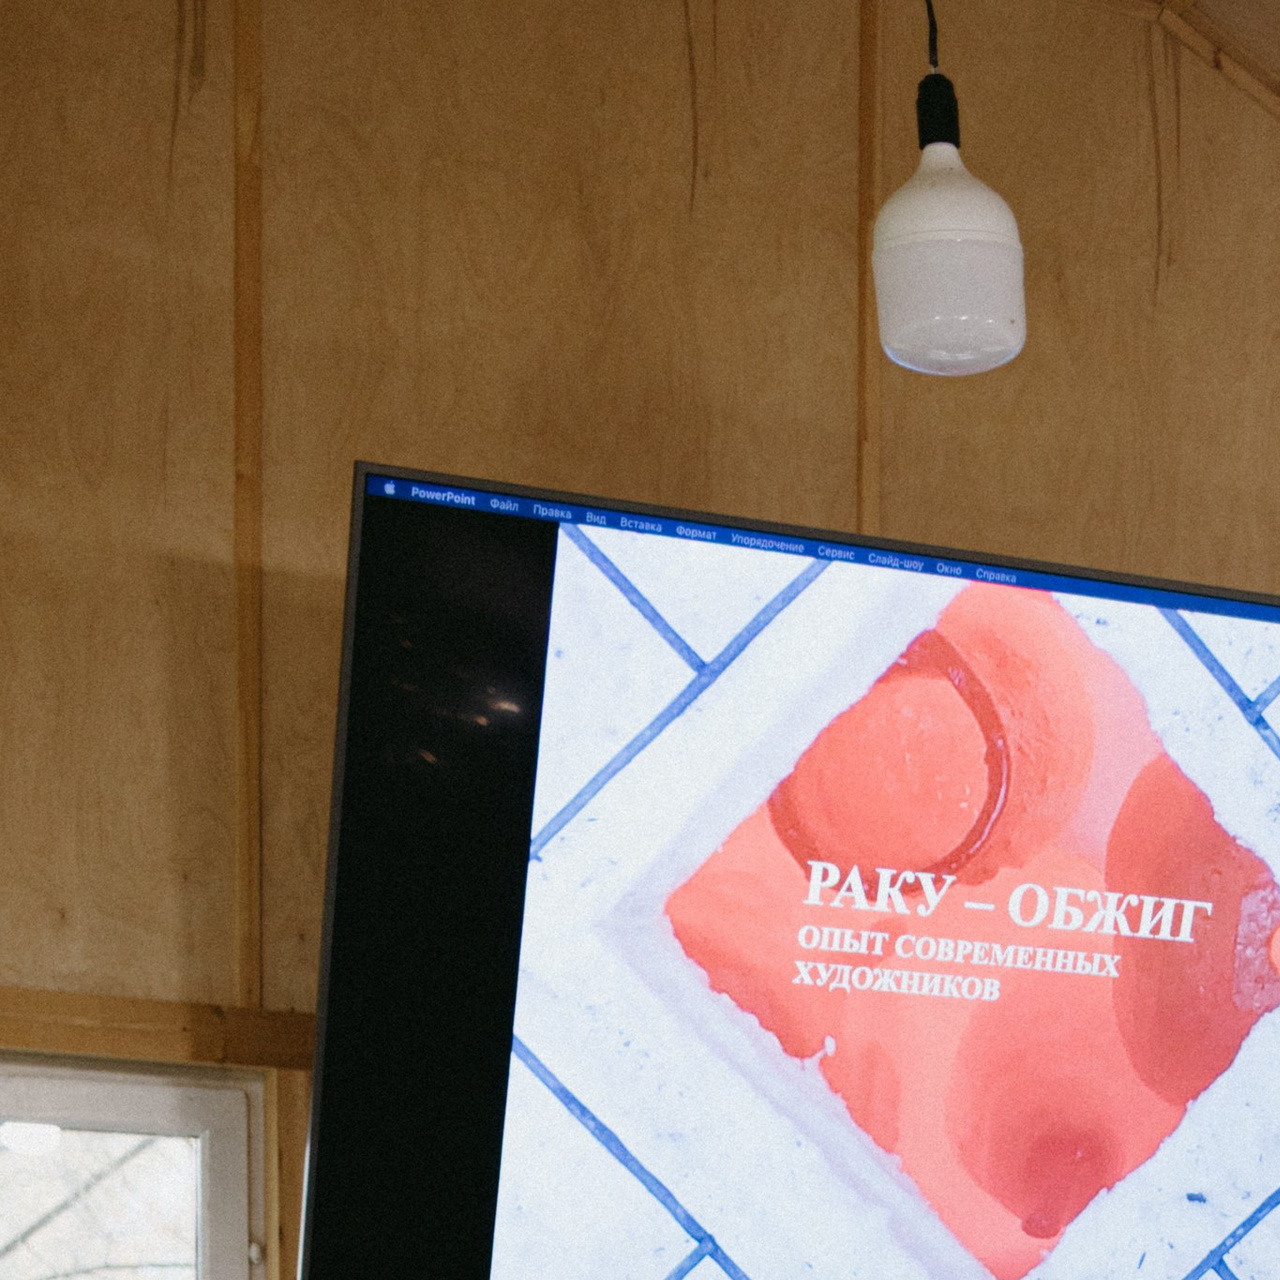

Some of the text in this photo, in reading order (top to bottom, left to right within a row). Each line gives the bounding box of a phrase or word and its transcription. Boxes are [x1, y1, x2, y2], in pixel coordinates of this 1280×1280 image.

[411, 486, 1017, 584] PowerPoint Файл Правка Вид Вставка Формат Упорядочение Сервис Слайд-шоу Окно Справка
[802, 860, 956, 917] РАКУ
[1008, 882, 1213, 943] ОБЖИГ
[792, 960, 1001, 1001] ХУДОЖНИКОВ
[797, 925, 1121, 978] ОПЫТ СОВРЕМЕННЫХ
